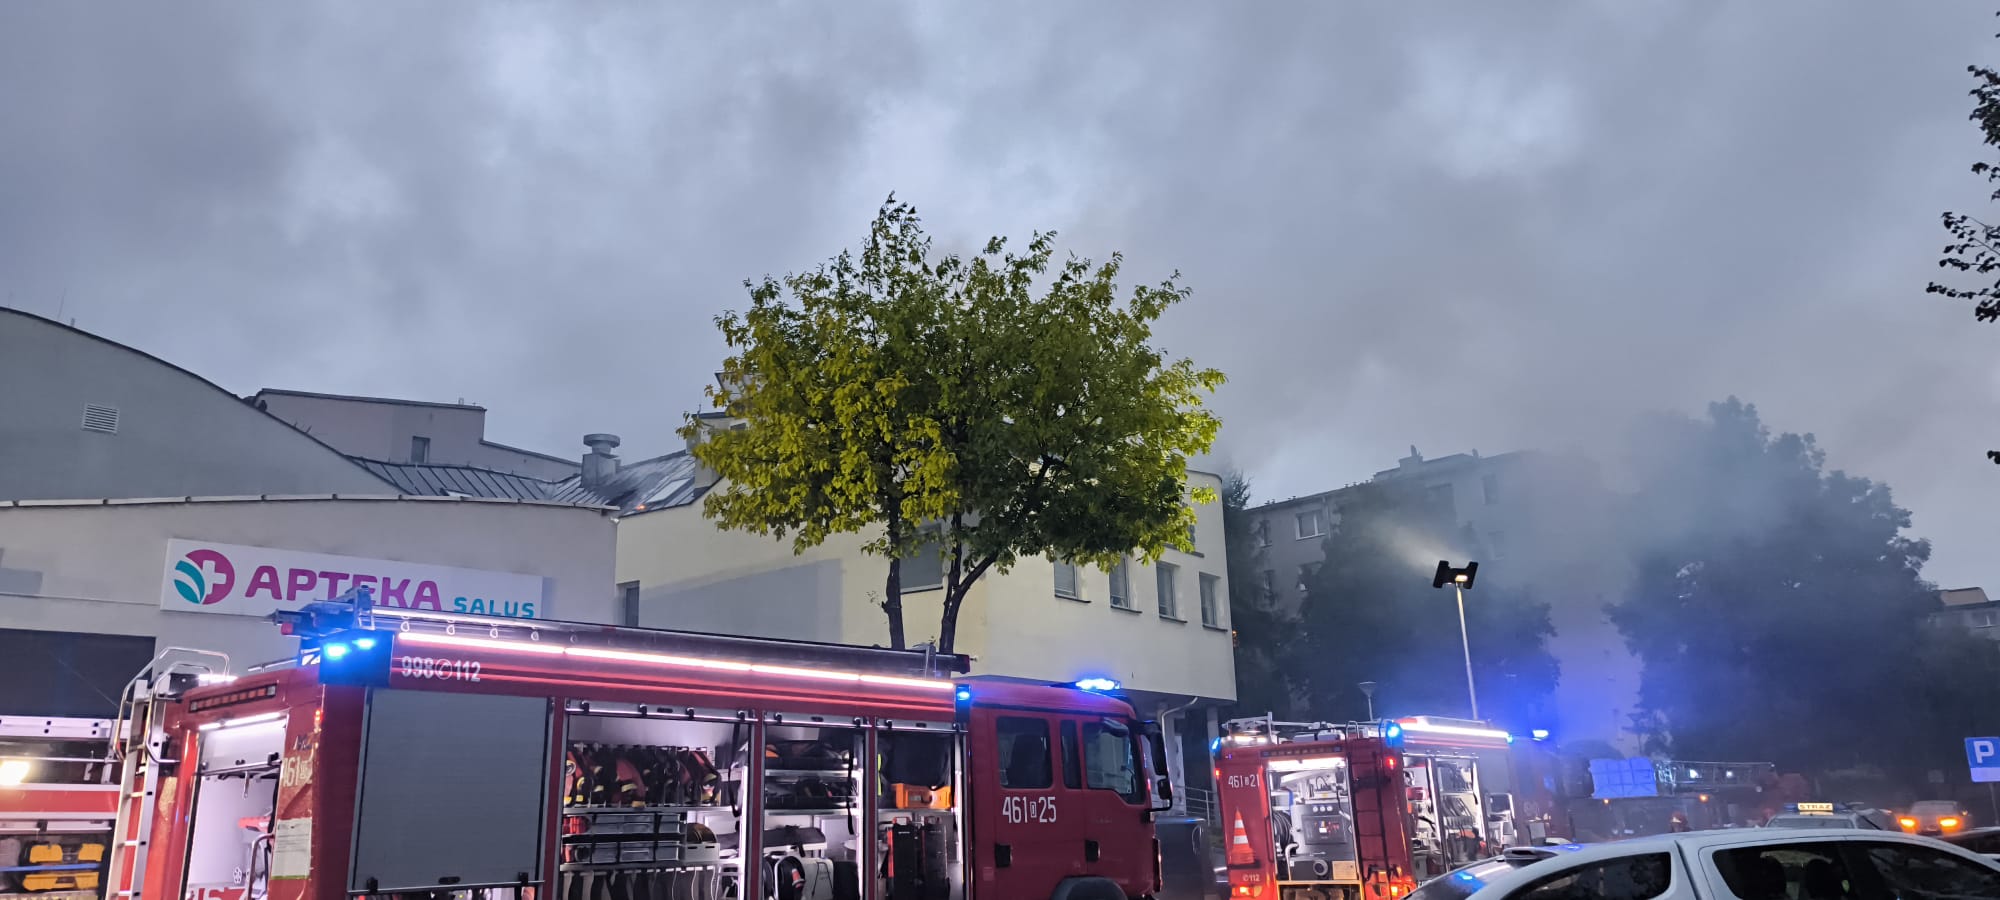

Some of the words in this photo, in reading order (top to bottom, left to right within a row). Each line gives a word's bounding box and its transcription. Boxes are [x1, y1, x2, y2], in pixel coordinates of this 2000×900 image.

[245, 564, 442, 612] APTEKA
[453, 596, 535, 619] SALUS
[1973, 740, 1994, 764] P
